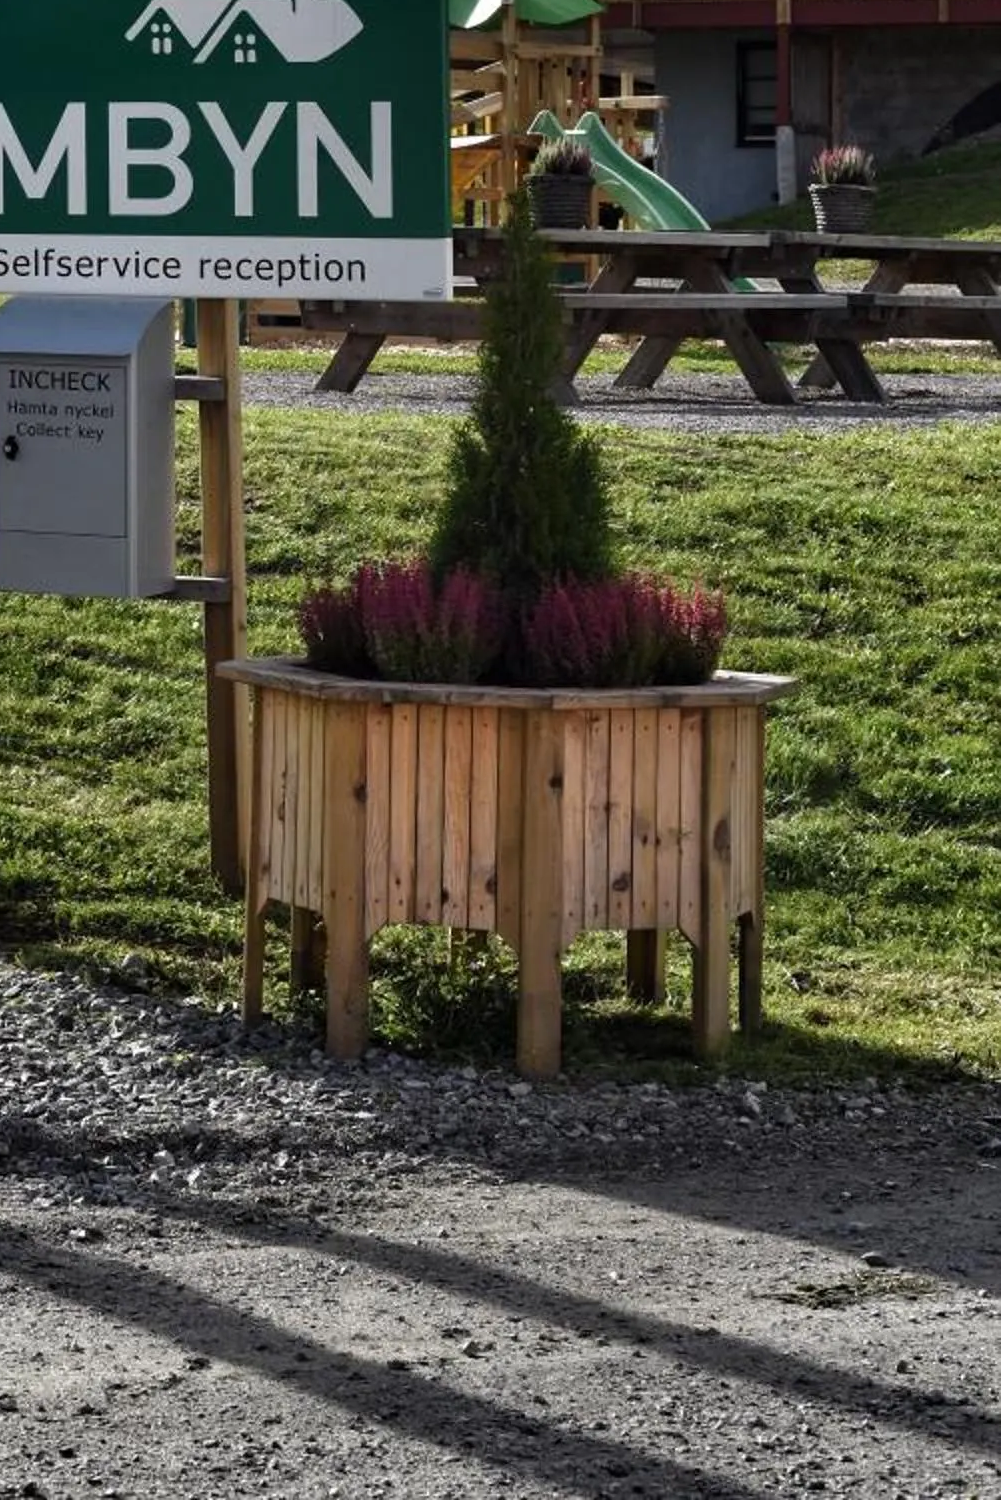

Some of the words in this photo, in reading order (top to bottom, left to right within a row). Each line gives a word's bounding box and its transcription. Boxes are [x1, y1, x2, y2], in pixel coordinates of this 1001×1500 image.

[199, 253, 367, 286] reception
[9, 369, 111, 392] INCHECK
[65, 403, 114, 419] nyckel
[16, 422, 70, 438] Collect
[78, 425, 104, 442] key
